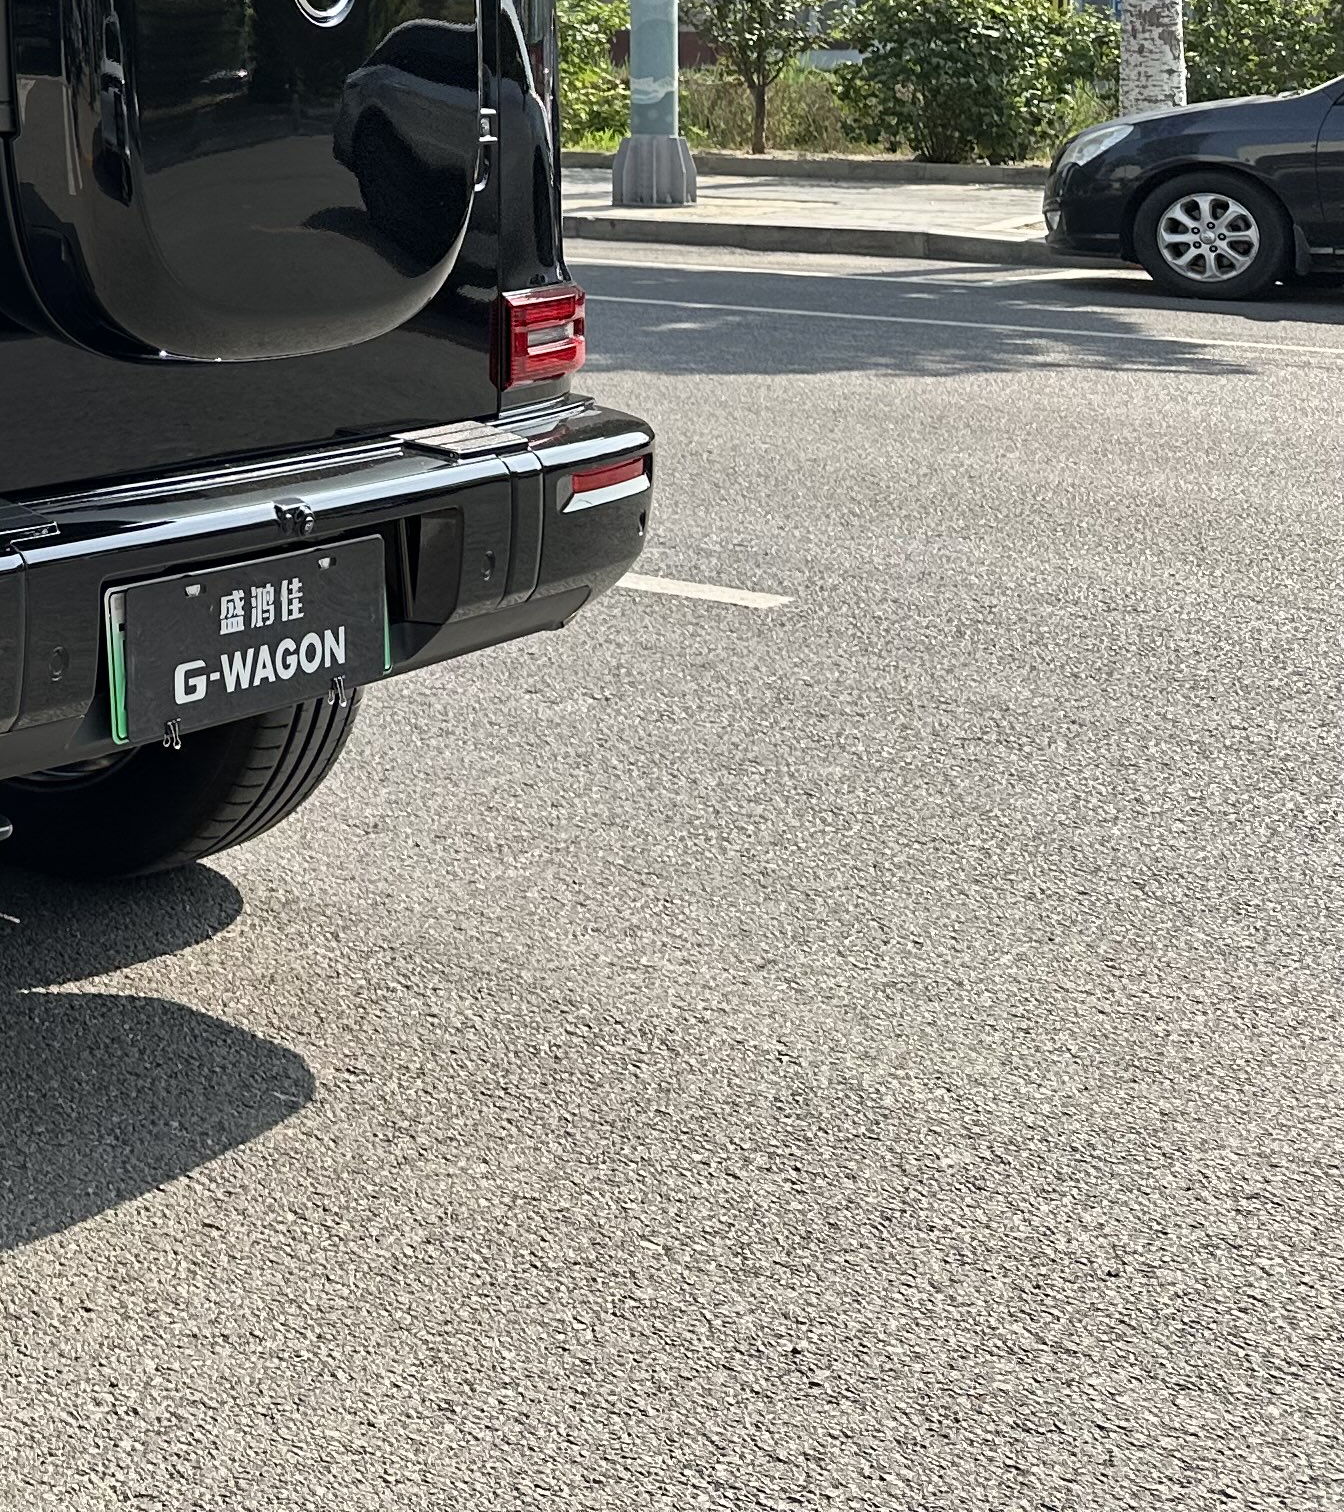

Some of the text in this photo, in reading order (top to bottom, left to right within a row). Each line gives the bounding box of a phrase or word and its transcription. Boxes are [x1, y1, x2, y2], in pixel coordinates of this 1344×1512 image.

[219, 577, 304, 635] 盛鸿佳
[174, 626, 346, 705] G-WAGON
